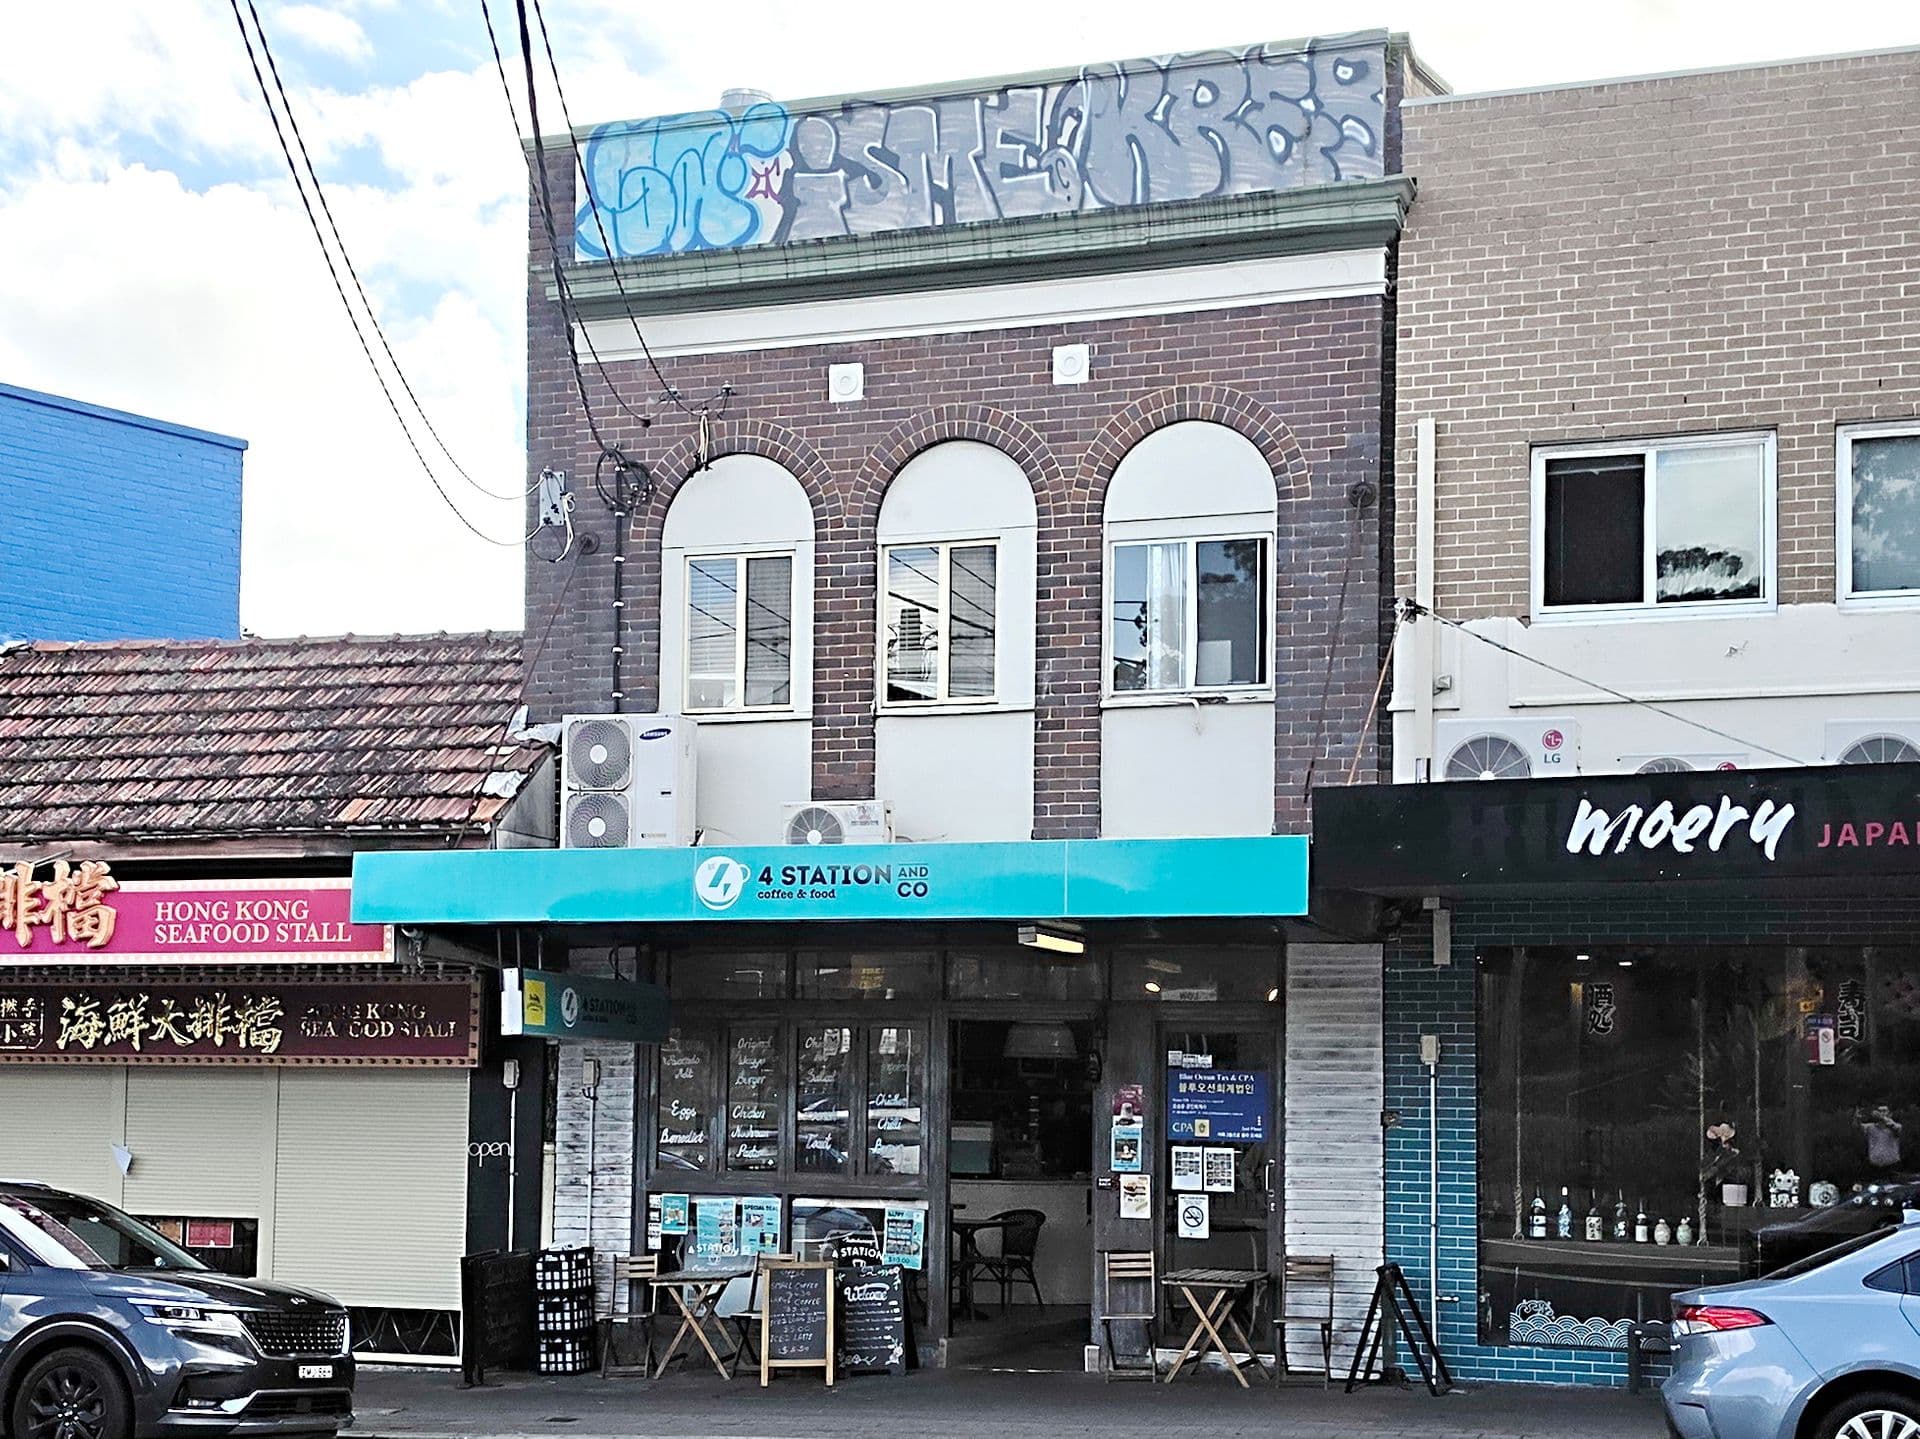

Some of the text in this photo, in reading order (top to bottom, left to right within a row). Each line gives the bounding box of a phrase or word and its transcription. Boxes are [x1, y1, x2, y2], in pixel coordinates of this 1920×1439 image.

[1544, 754, 1560, 763] LG
[1566, 795, 1795, 861] moery
[1818, 821, 1920, 847] JAPA
[758, 865, 892, 886] 4 STATION
[898, 866, 928, 877] AND
[757, 889, 836, 899] coffee & food
[897, 882, 928, 897] CO
[155, 900, 309, 921] HONG KONG
[155, 922, 352, 943] SEAFOOD STALL
[56, 992, 284, 1053] 海鮮大排檔
[1238, 1074, 1255, 1082] CPA
[671, 1099, 697, 1120] Eggs
[1172, 1122, 1194, 1133] CPA
[468, 1142, 511, 1167] open
